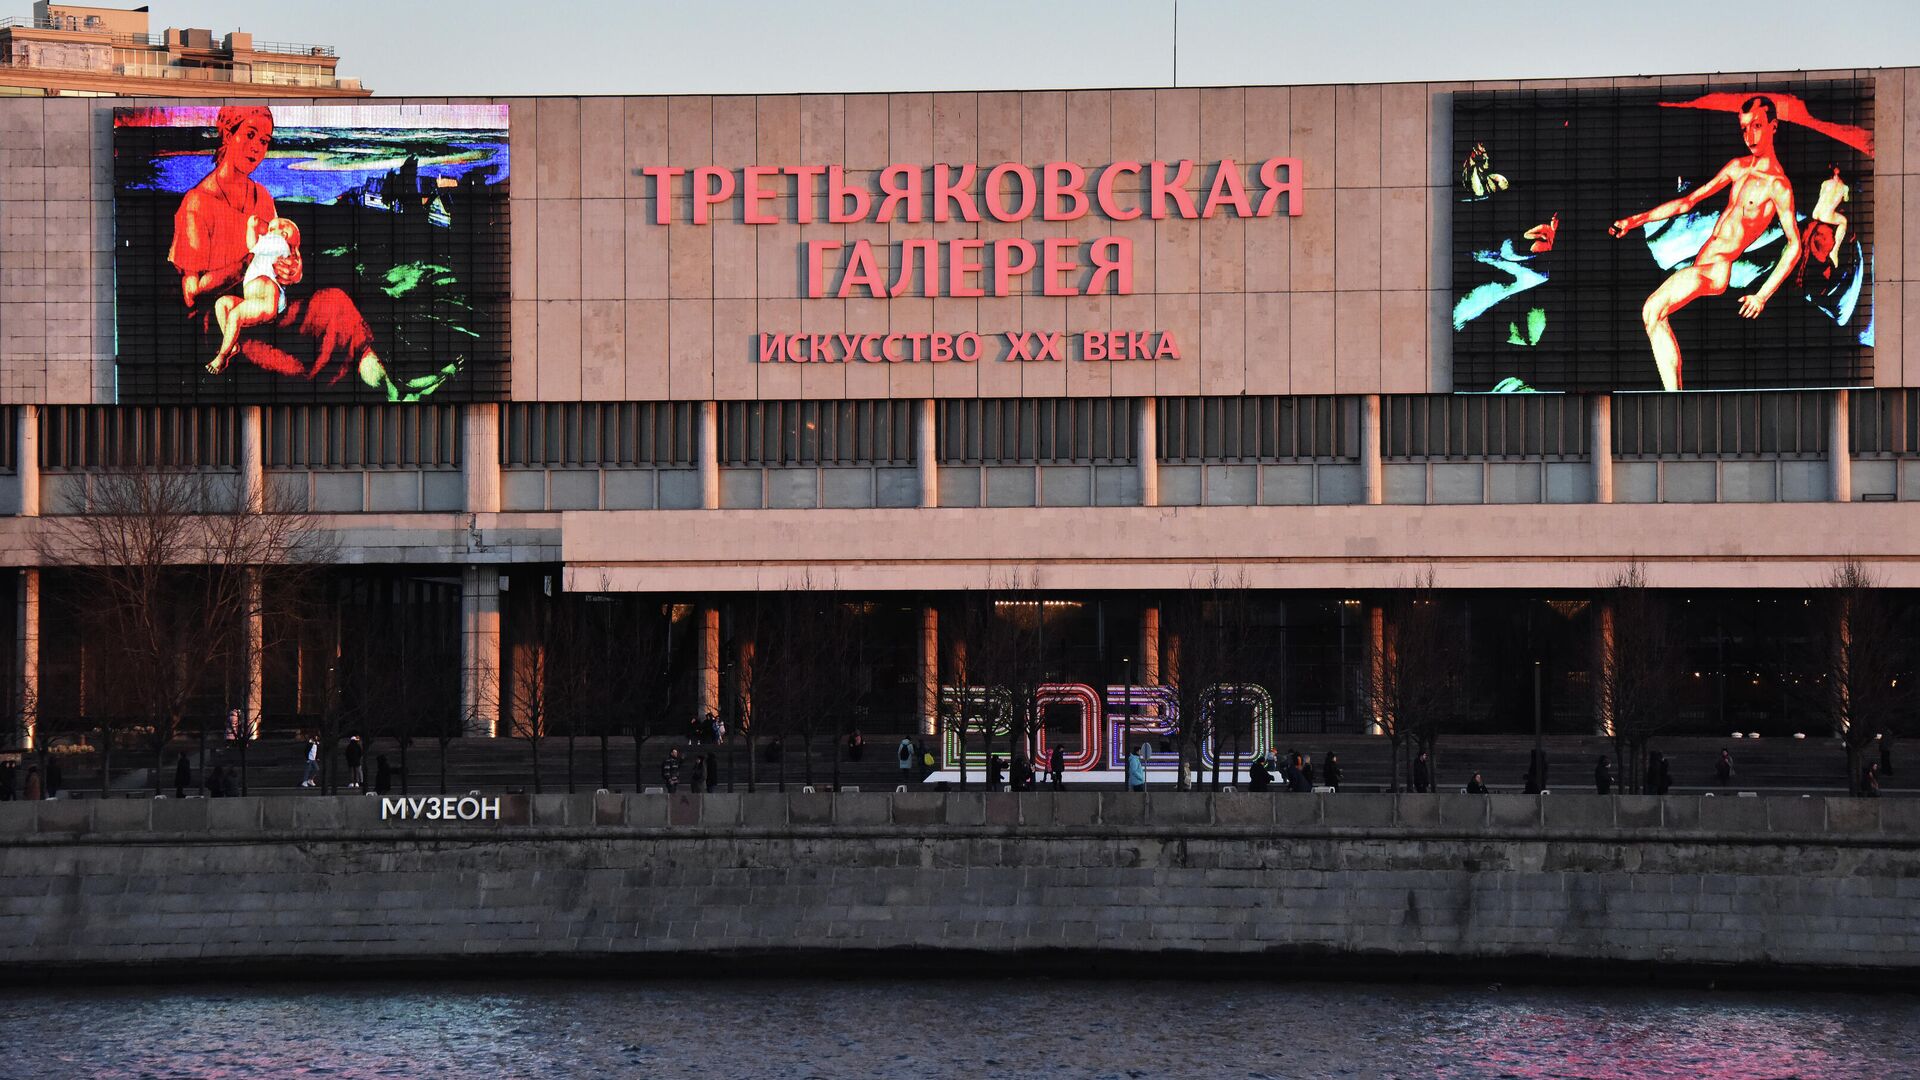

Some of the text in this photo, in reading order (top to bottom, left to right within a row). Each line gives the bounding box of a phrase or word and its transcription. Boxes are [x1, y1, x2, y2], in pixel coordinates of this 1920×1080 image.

[644, 157, 1304, 225] ТРЕТЬЯКОВСКАЯ
[807, 236, 1133, 298] ГАЛЕРЕЯ
[758, 331, 983, 363] ИСКУССТВО
[1083, 330, 1181, 361] ВЕКА
[942, 683, 1274, 772] 2020
[381, 797, 501, 820] МУЗЕОН
